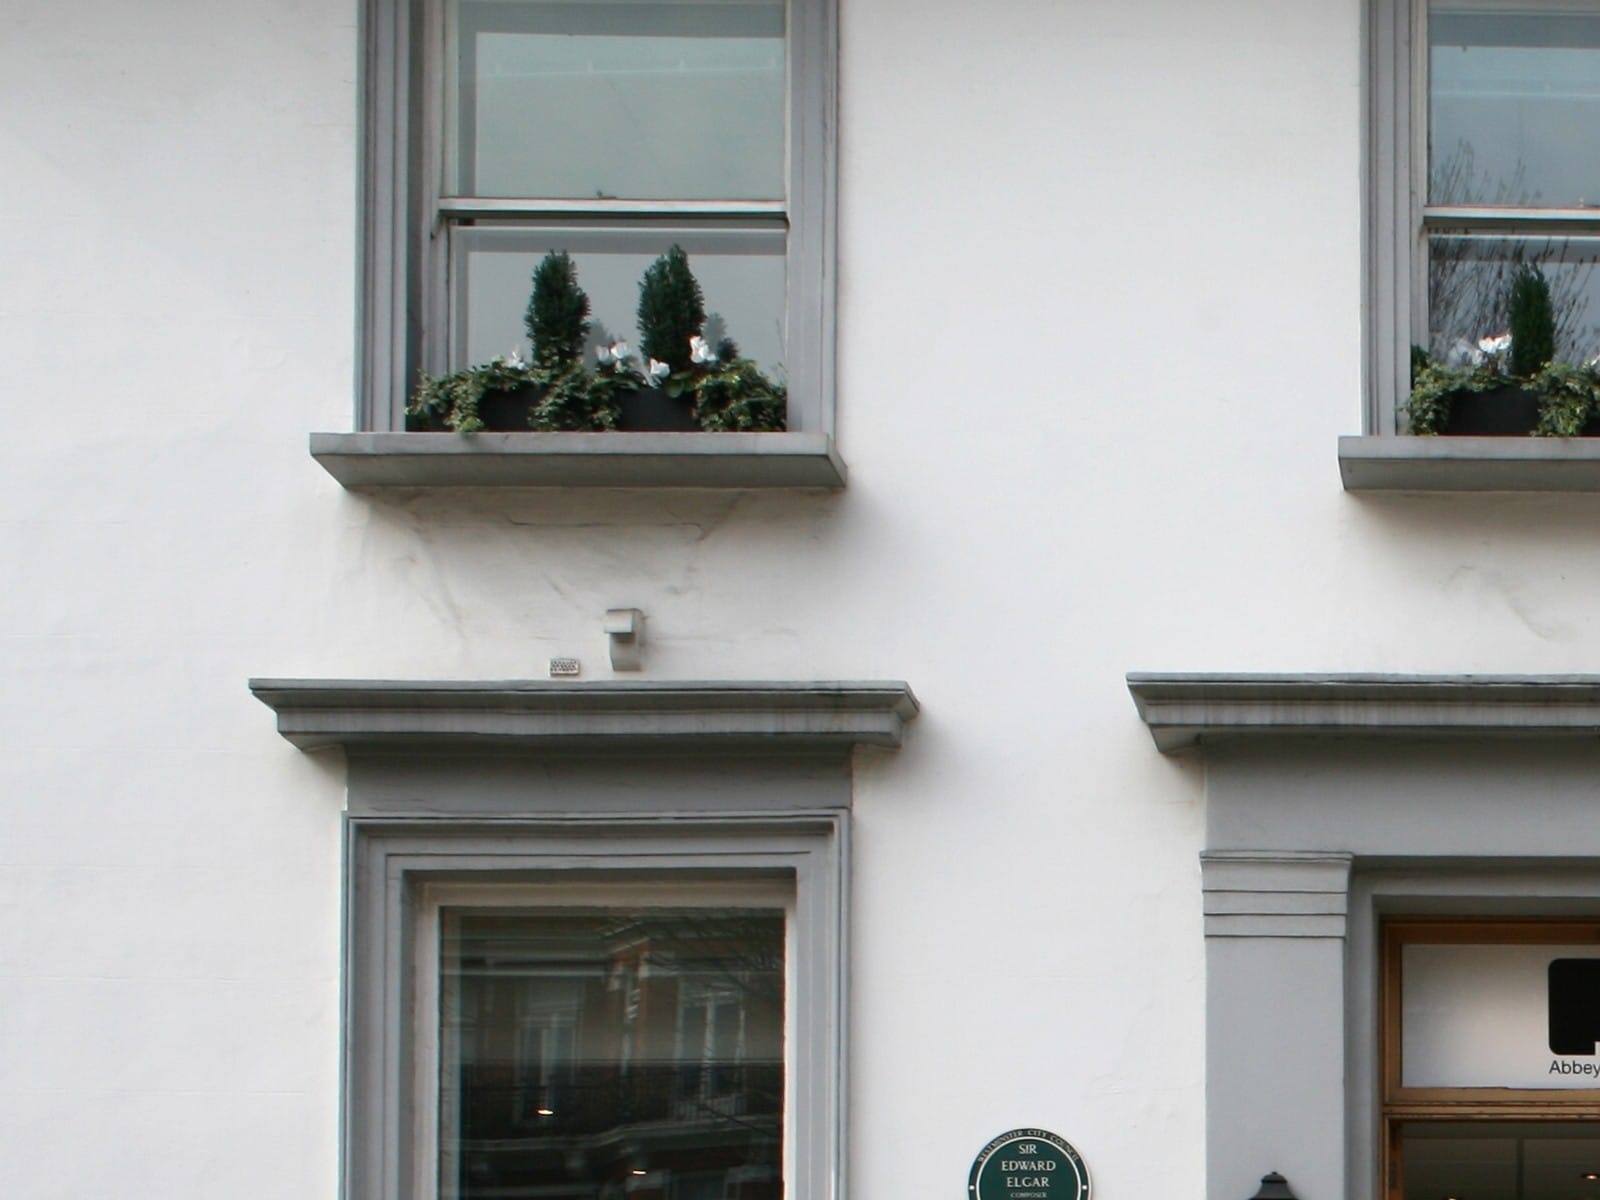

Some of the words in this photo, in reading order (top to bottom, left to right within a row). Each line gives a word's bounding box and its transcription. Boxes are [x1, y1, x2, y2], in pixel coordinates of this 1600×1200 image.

[1027, 1130, 1047, 1138] CITY
[1018, 1144, 1037, 1154] SIR
[1002, 1160, 1056, 1171] EDWARD
[1006, 1177, 1050, 1187] ELGAR
